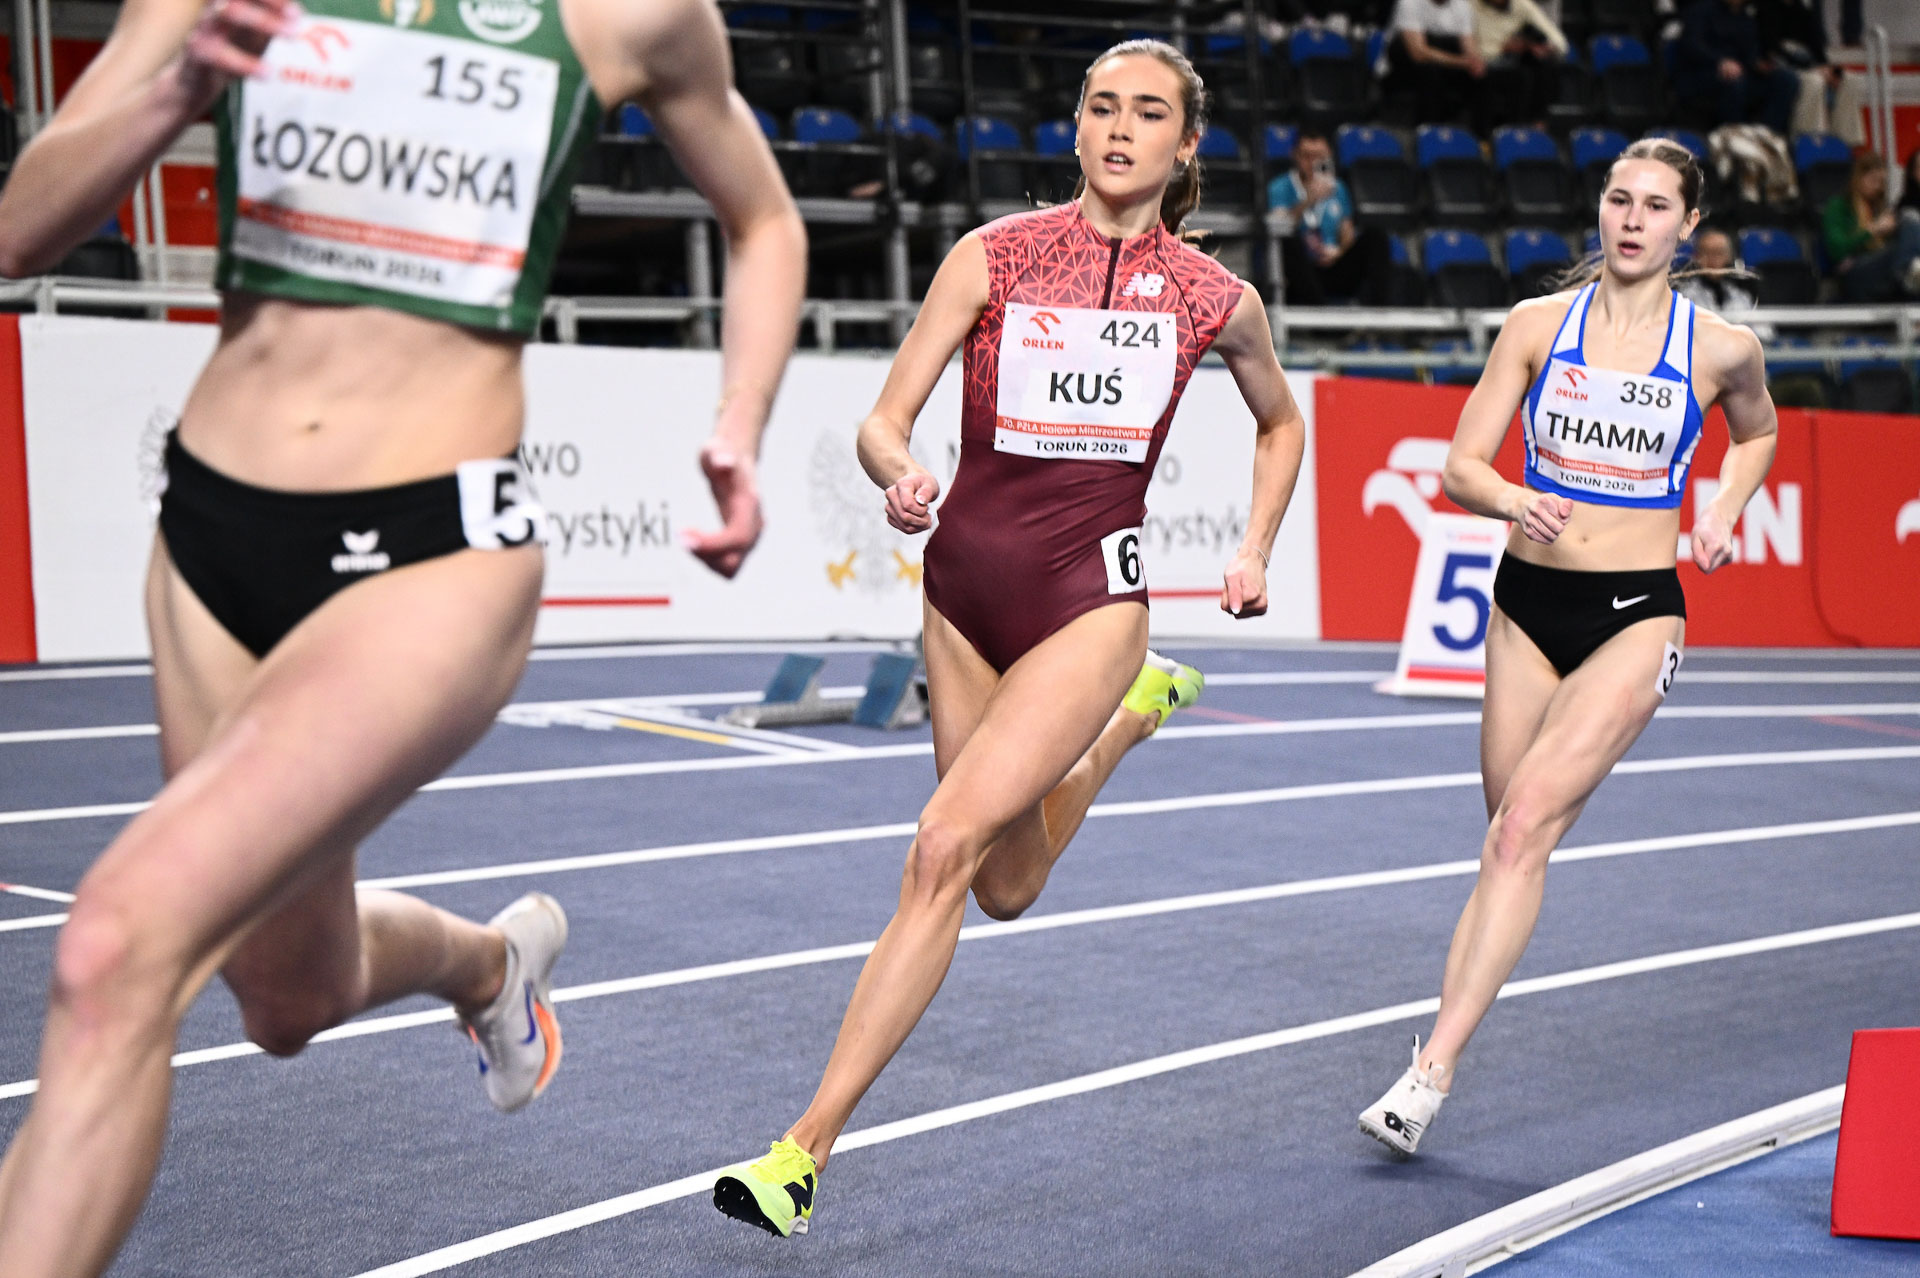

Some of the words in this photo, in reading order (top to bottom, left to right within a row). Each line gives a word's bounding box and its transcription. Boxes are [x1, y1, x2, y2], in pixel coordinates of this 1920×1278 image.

[424, 53, 525, 112] 155
[252, 112, 518, 212] ŁOZOWSKA
[1022, 337, 1064, 351] ORLEN
[1099, 320, 1161, 349] 424
[1049, 367, 1123, 405] KUŚ
[1555, 388, 1588, 401] ORLEN
[1619, 381, 1673, 409] 358
[1040, 424, 1077, 436] Halowe
[1078, 425, 1137, 439] Mistrzostwa
[1091, 442, 1128, 455] 2026
[1546, 411, 1665, 454] THAMM
[1604, 481, 1636, 492] 2026
[495, 471, 536, 547] 5
[1118, 534, 1140, 586] 6
[1431, 552, 1492, 653] 5
[1663, 651, 1678, 693] 3
